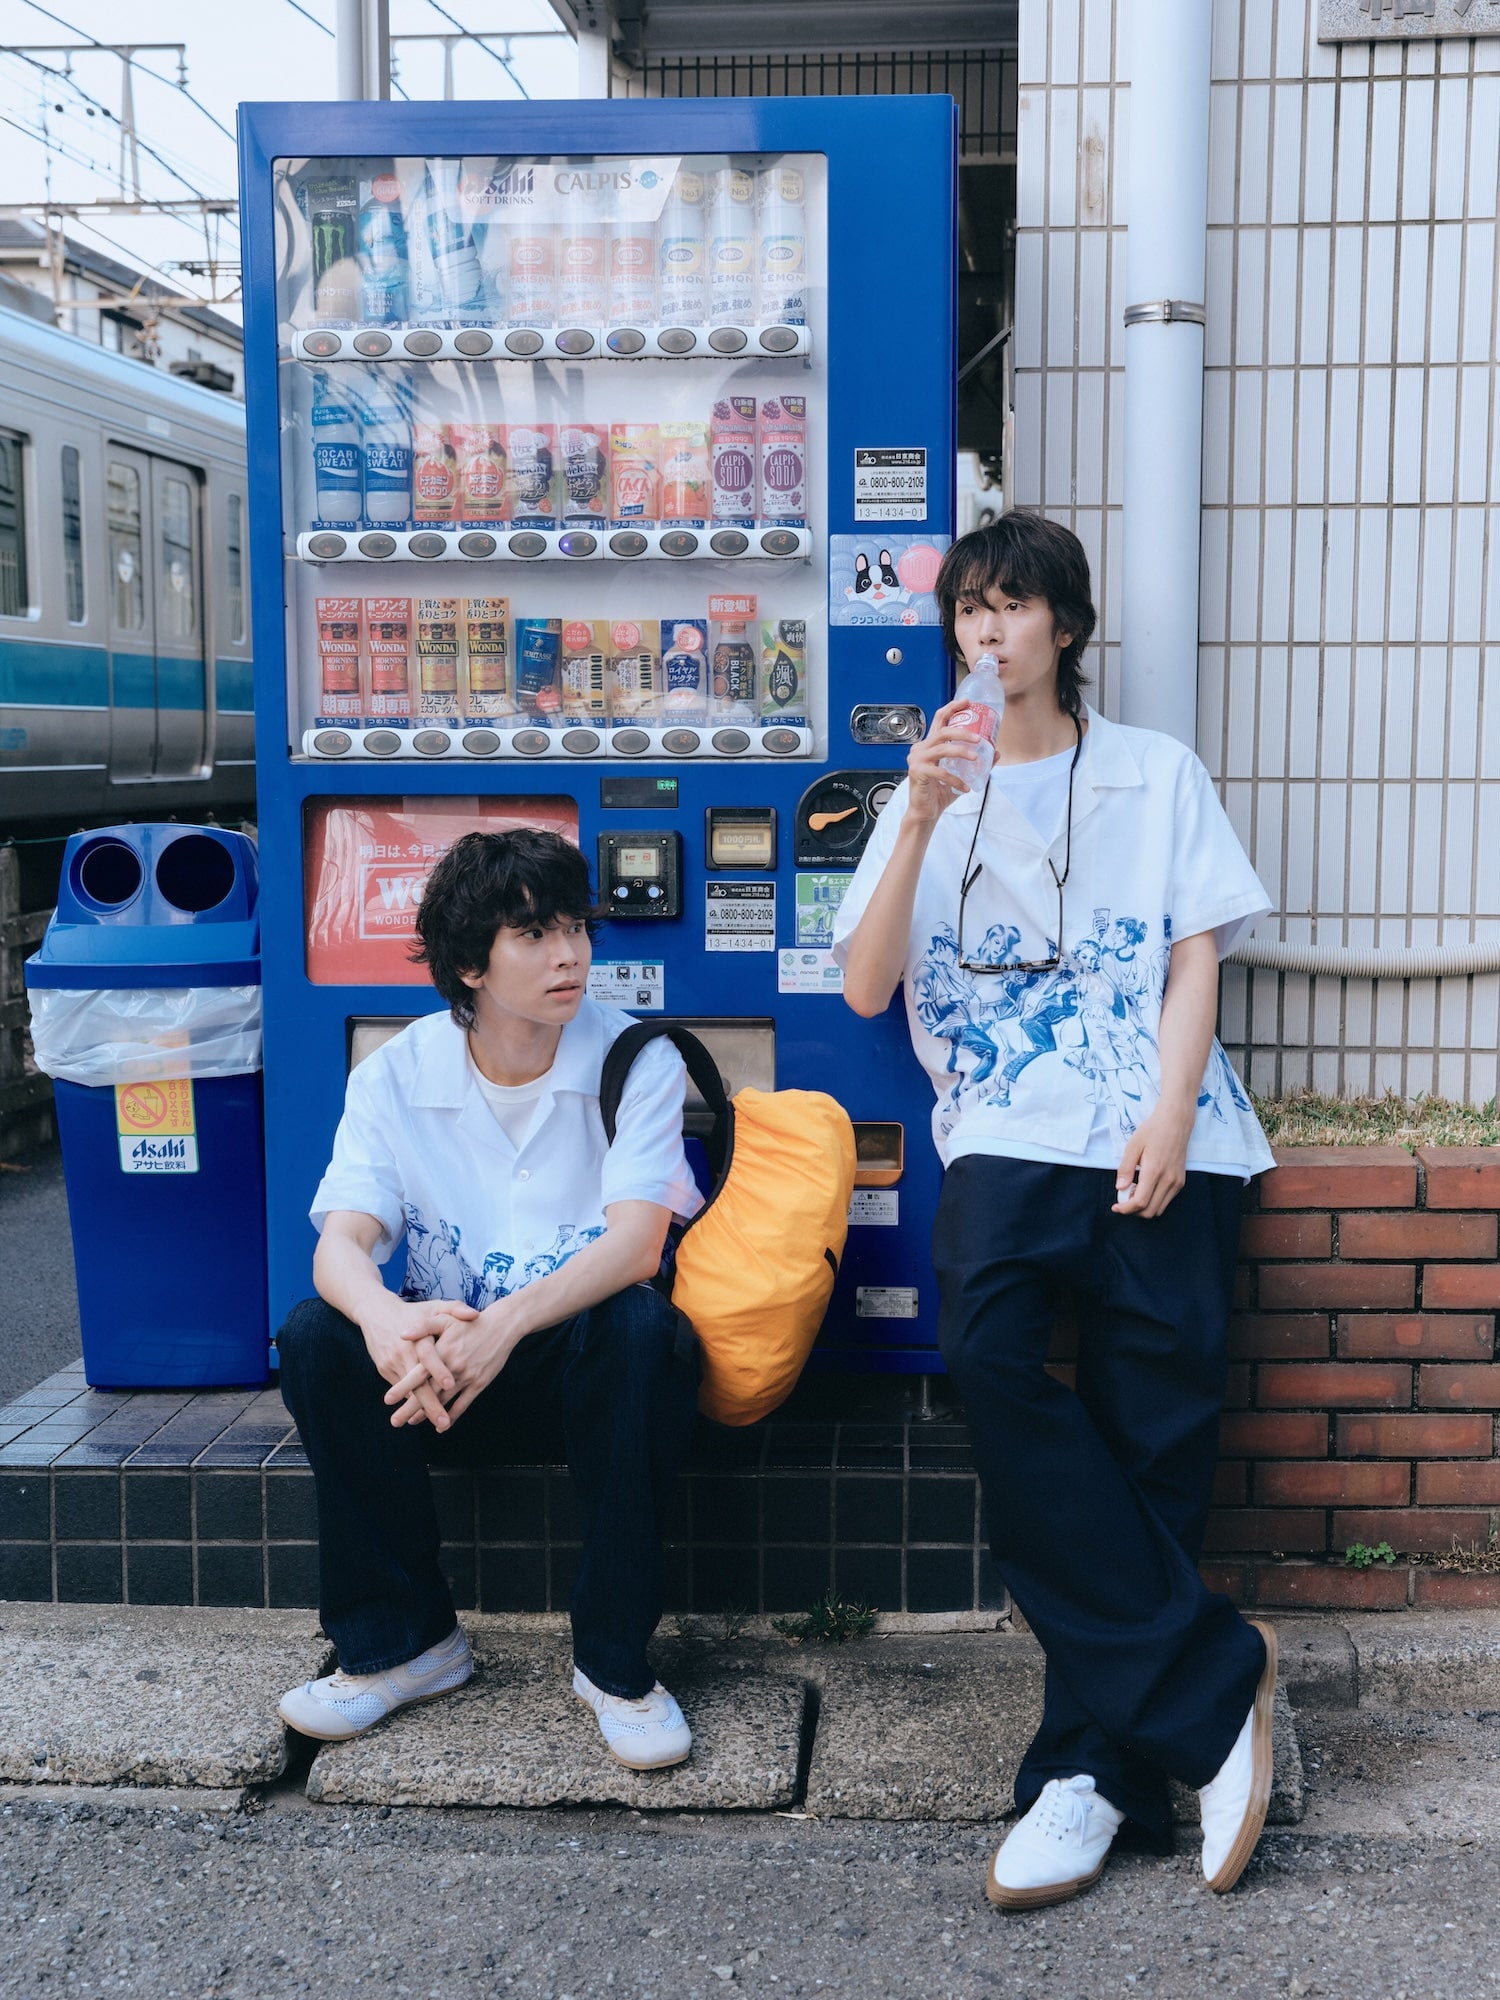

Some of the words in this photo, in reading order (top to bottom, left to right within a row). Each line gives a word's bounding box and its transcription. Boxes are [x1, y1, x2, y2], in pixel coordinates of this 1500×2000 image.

[554, 172, 631, 195] CALPIS
[464, 194, 493, 205] SOFT
[494, 194, 534, 205] DRINKS
[661, 275, 704, 284] LEMON
[711, 274, 753, 283] LEMON
[761, 273, 803, 283] LEMON
[318, 450, 357, 459] POCARI
[367, 450, 407, 459] POCARI
[318, 459, 353, 467] SWEAT
[367, 459, 404, 467] SWEAT
[720, 455, 745, 466] CALPIS
[770, 455, 795, 465] CALPIS
[720, 468, 746, 486] SODA
[770, 467, 796, 486] SODA
[870, 477, 924, 488] 0800-800-2109
[420, 487, 448, 497] ストロング
[470, 486, 498, 496] ストロング
[859, 508, 923, 517] 13-1434-01
[318, 600, 359, 611] 新・ワンダ
[367, 600, 408, 611] 新・ワンダ
[417, 610, 457, 620] 香りとコク
[466, 610, 505, 620] 香りとコク
[321, 641, 357, 653] WONDA
[369, 641, 407, 653] WONDA
[418, 641, 455, 653] WONDA
[468, 641, 504, 653] WONDA
[668, 666, 697, 674] ロイヤル
[730, 660, 740, 690] BLACK
[322, 695, 362, 714] 朝専用
[371, 695, 411, 714] 朝専用
[420, 695, 458, 705] プレミアム
[722, 835, 761, 845] 1000円札
[720, 909, 773, 920] 0800-800-2109
[709, 939, 771, 947] 13-1434-01
[132, 1138, 186, 1158] Asahi
[132, 1160, 186, 1170] アサヒ飲料
